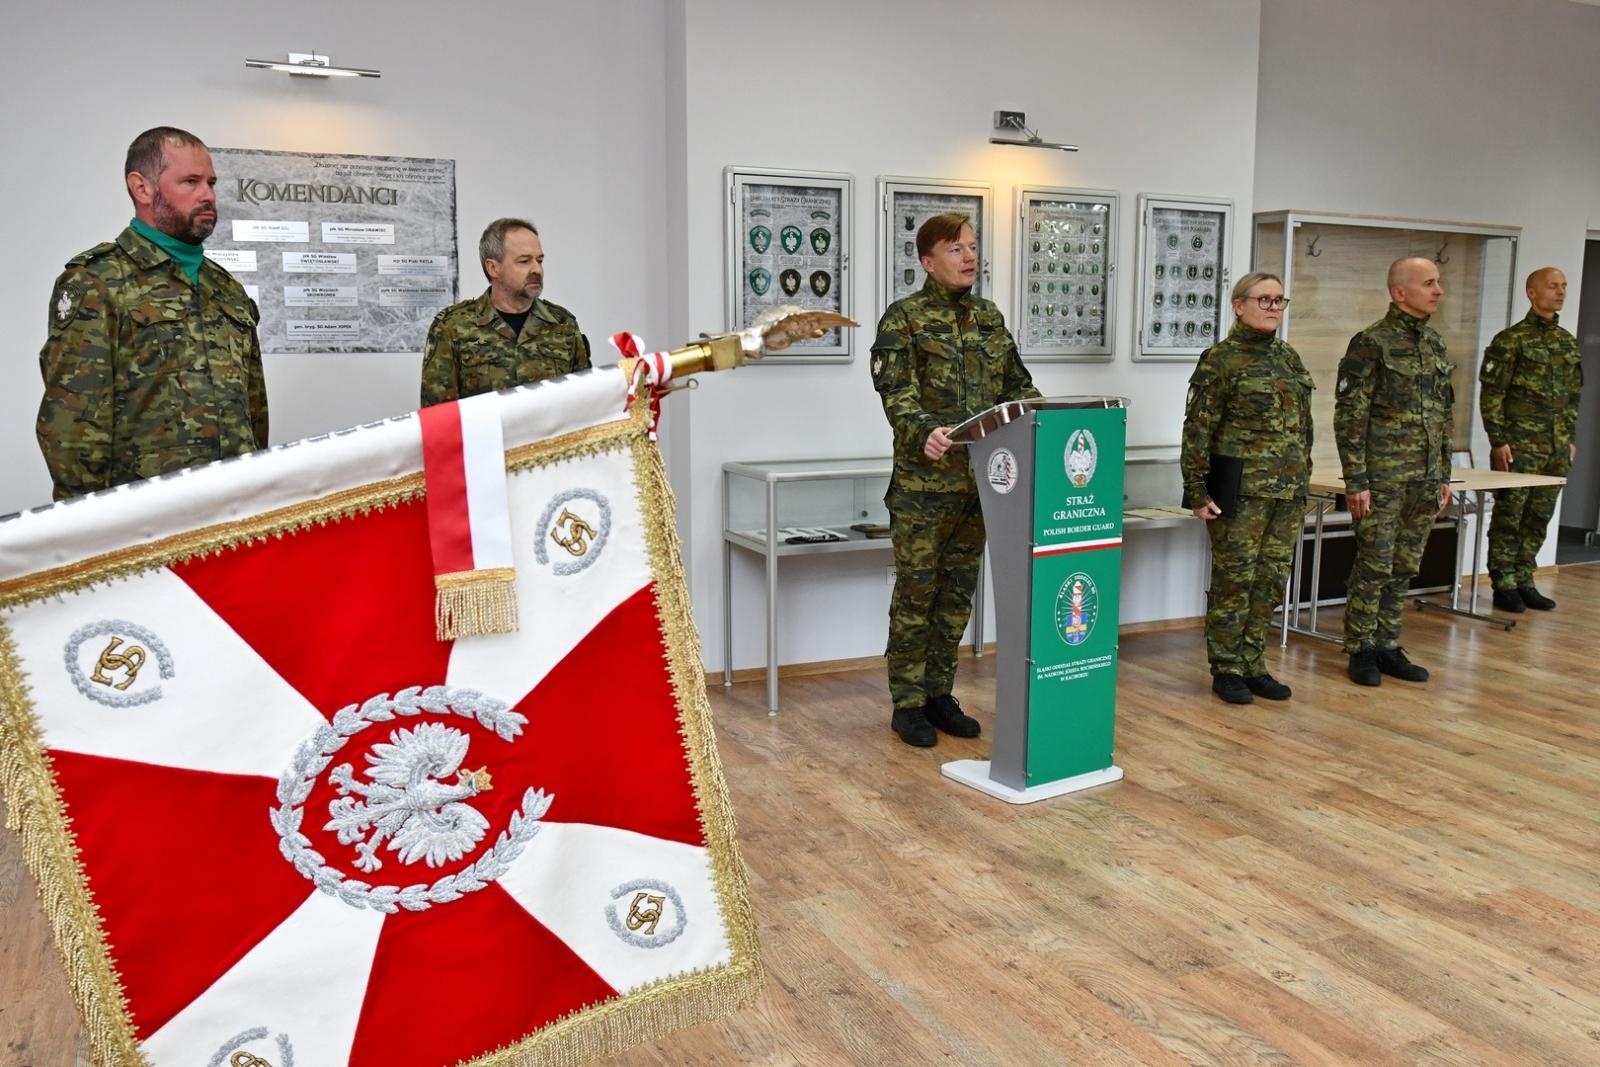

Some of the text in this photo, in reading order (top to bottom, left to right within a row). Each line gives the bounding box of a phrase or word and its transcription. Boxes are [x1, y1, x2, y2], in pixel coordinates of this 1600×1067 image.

[237, 178, 398, 206] KOMENDANCI
[1066, 493, 1094, 506] STRAŻ
[1053, 508, 1106, 520] GRANICZNA
[1044, 522, 1114, 536] POLISH BORDER GUARD
[1037, 666, 1052, 674] ŚLĄSKI
[1071, 658, 1086, 666] STRAŻY
[1087, 655, 1112, 663] GRANICZNEJ
